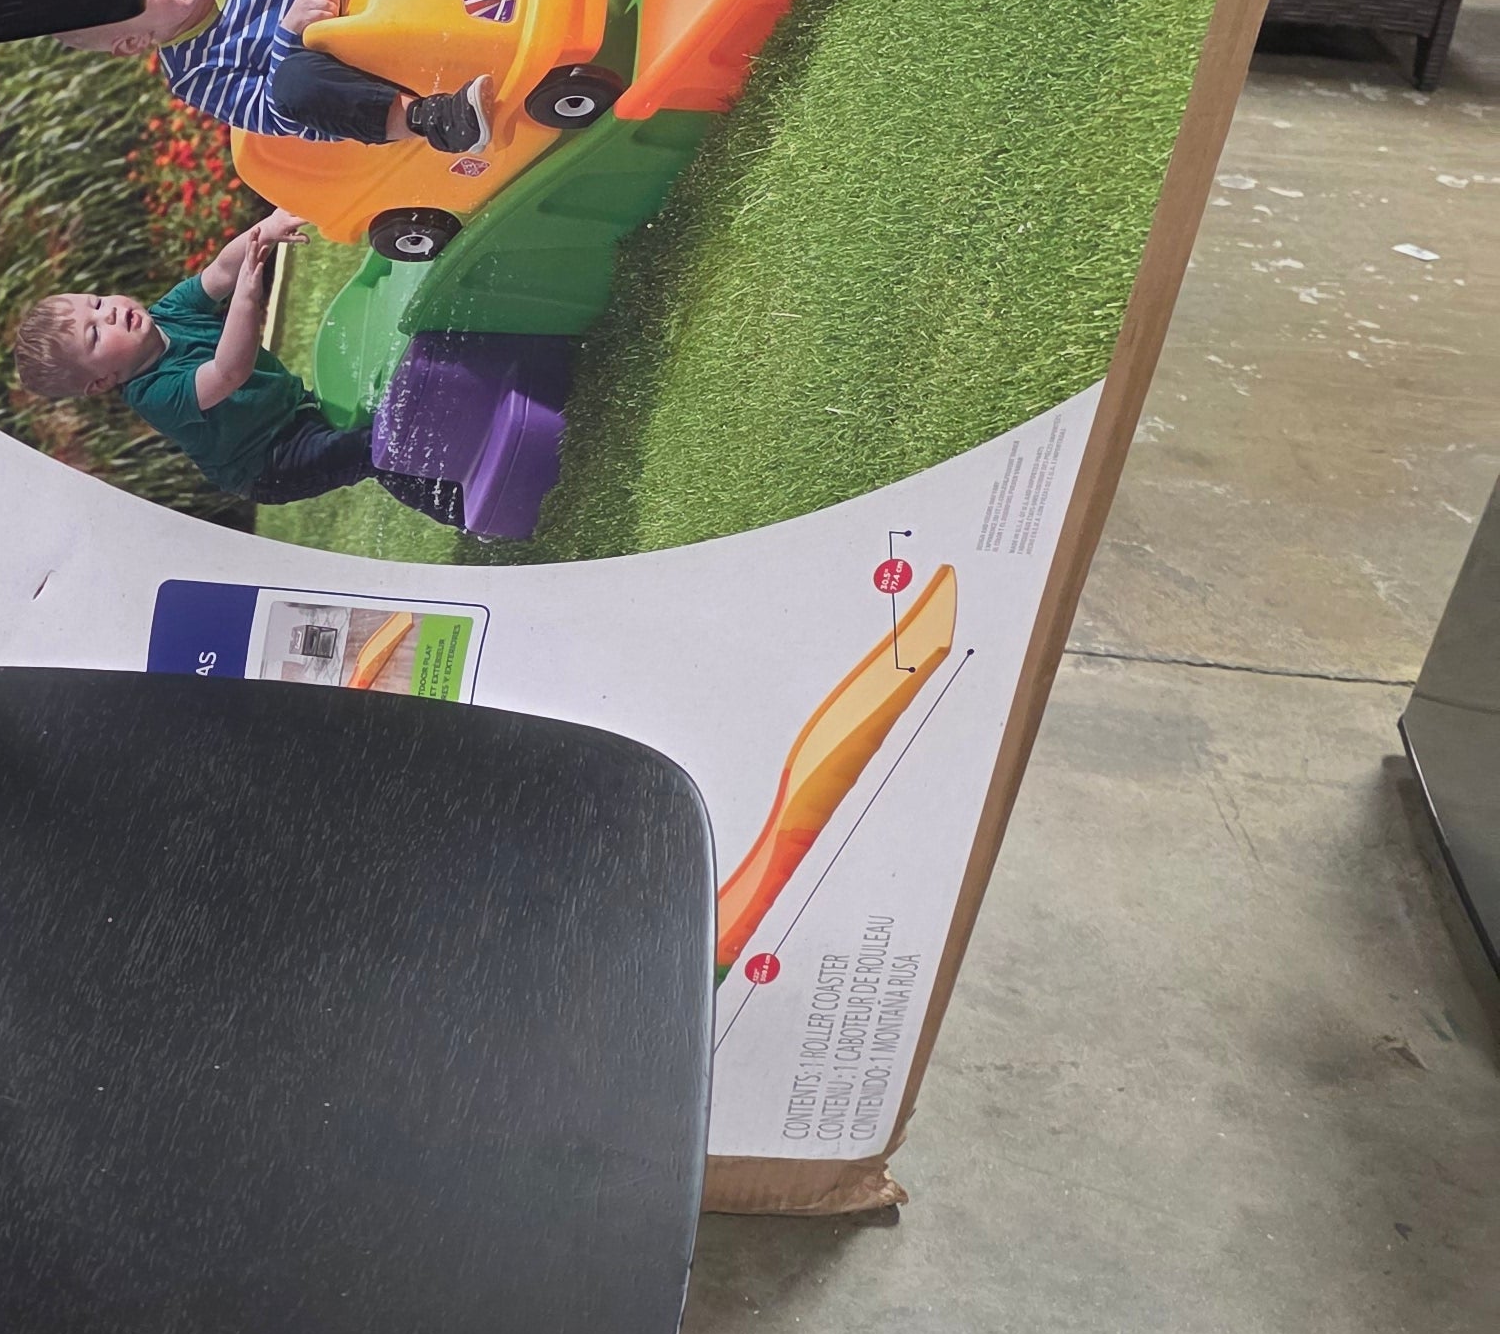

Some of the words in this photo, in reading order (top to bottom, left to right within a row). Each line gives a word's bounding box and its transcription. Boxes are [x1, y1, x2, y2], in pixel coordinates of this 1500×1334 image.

[896, 561, 903, 573] cm
[196, 652, 216, 676] AS
[423, 644, 432, 665] PLAY
[445, 624, 461, 675] EXTERIORES
[430, 687, 436, 696] ET
[857, 914, 895, 973] ROULEAU
[811, 954, 850, 1011] COASTER
[849, 976, 880, 993] DE
[887, 954, 921, 986] RUSA
[799, 1013, 836, 1059] ROLLER
[833, 996, 875, 1062] CABOTEUR
[870, 989, 914, 1053] MONTAÑA
[782, 1070, 823, 1140] CONTENTS:
[816, 1081, 854, 1141] CONTENU
[849, 1065, 893, 1141] CONTENIDO:
